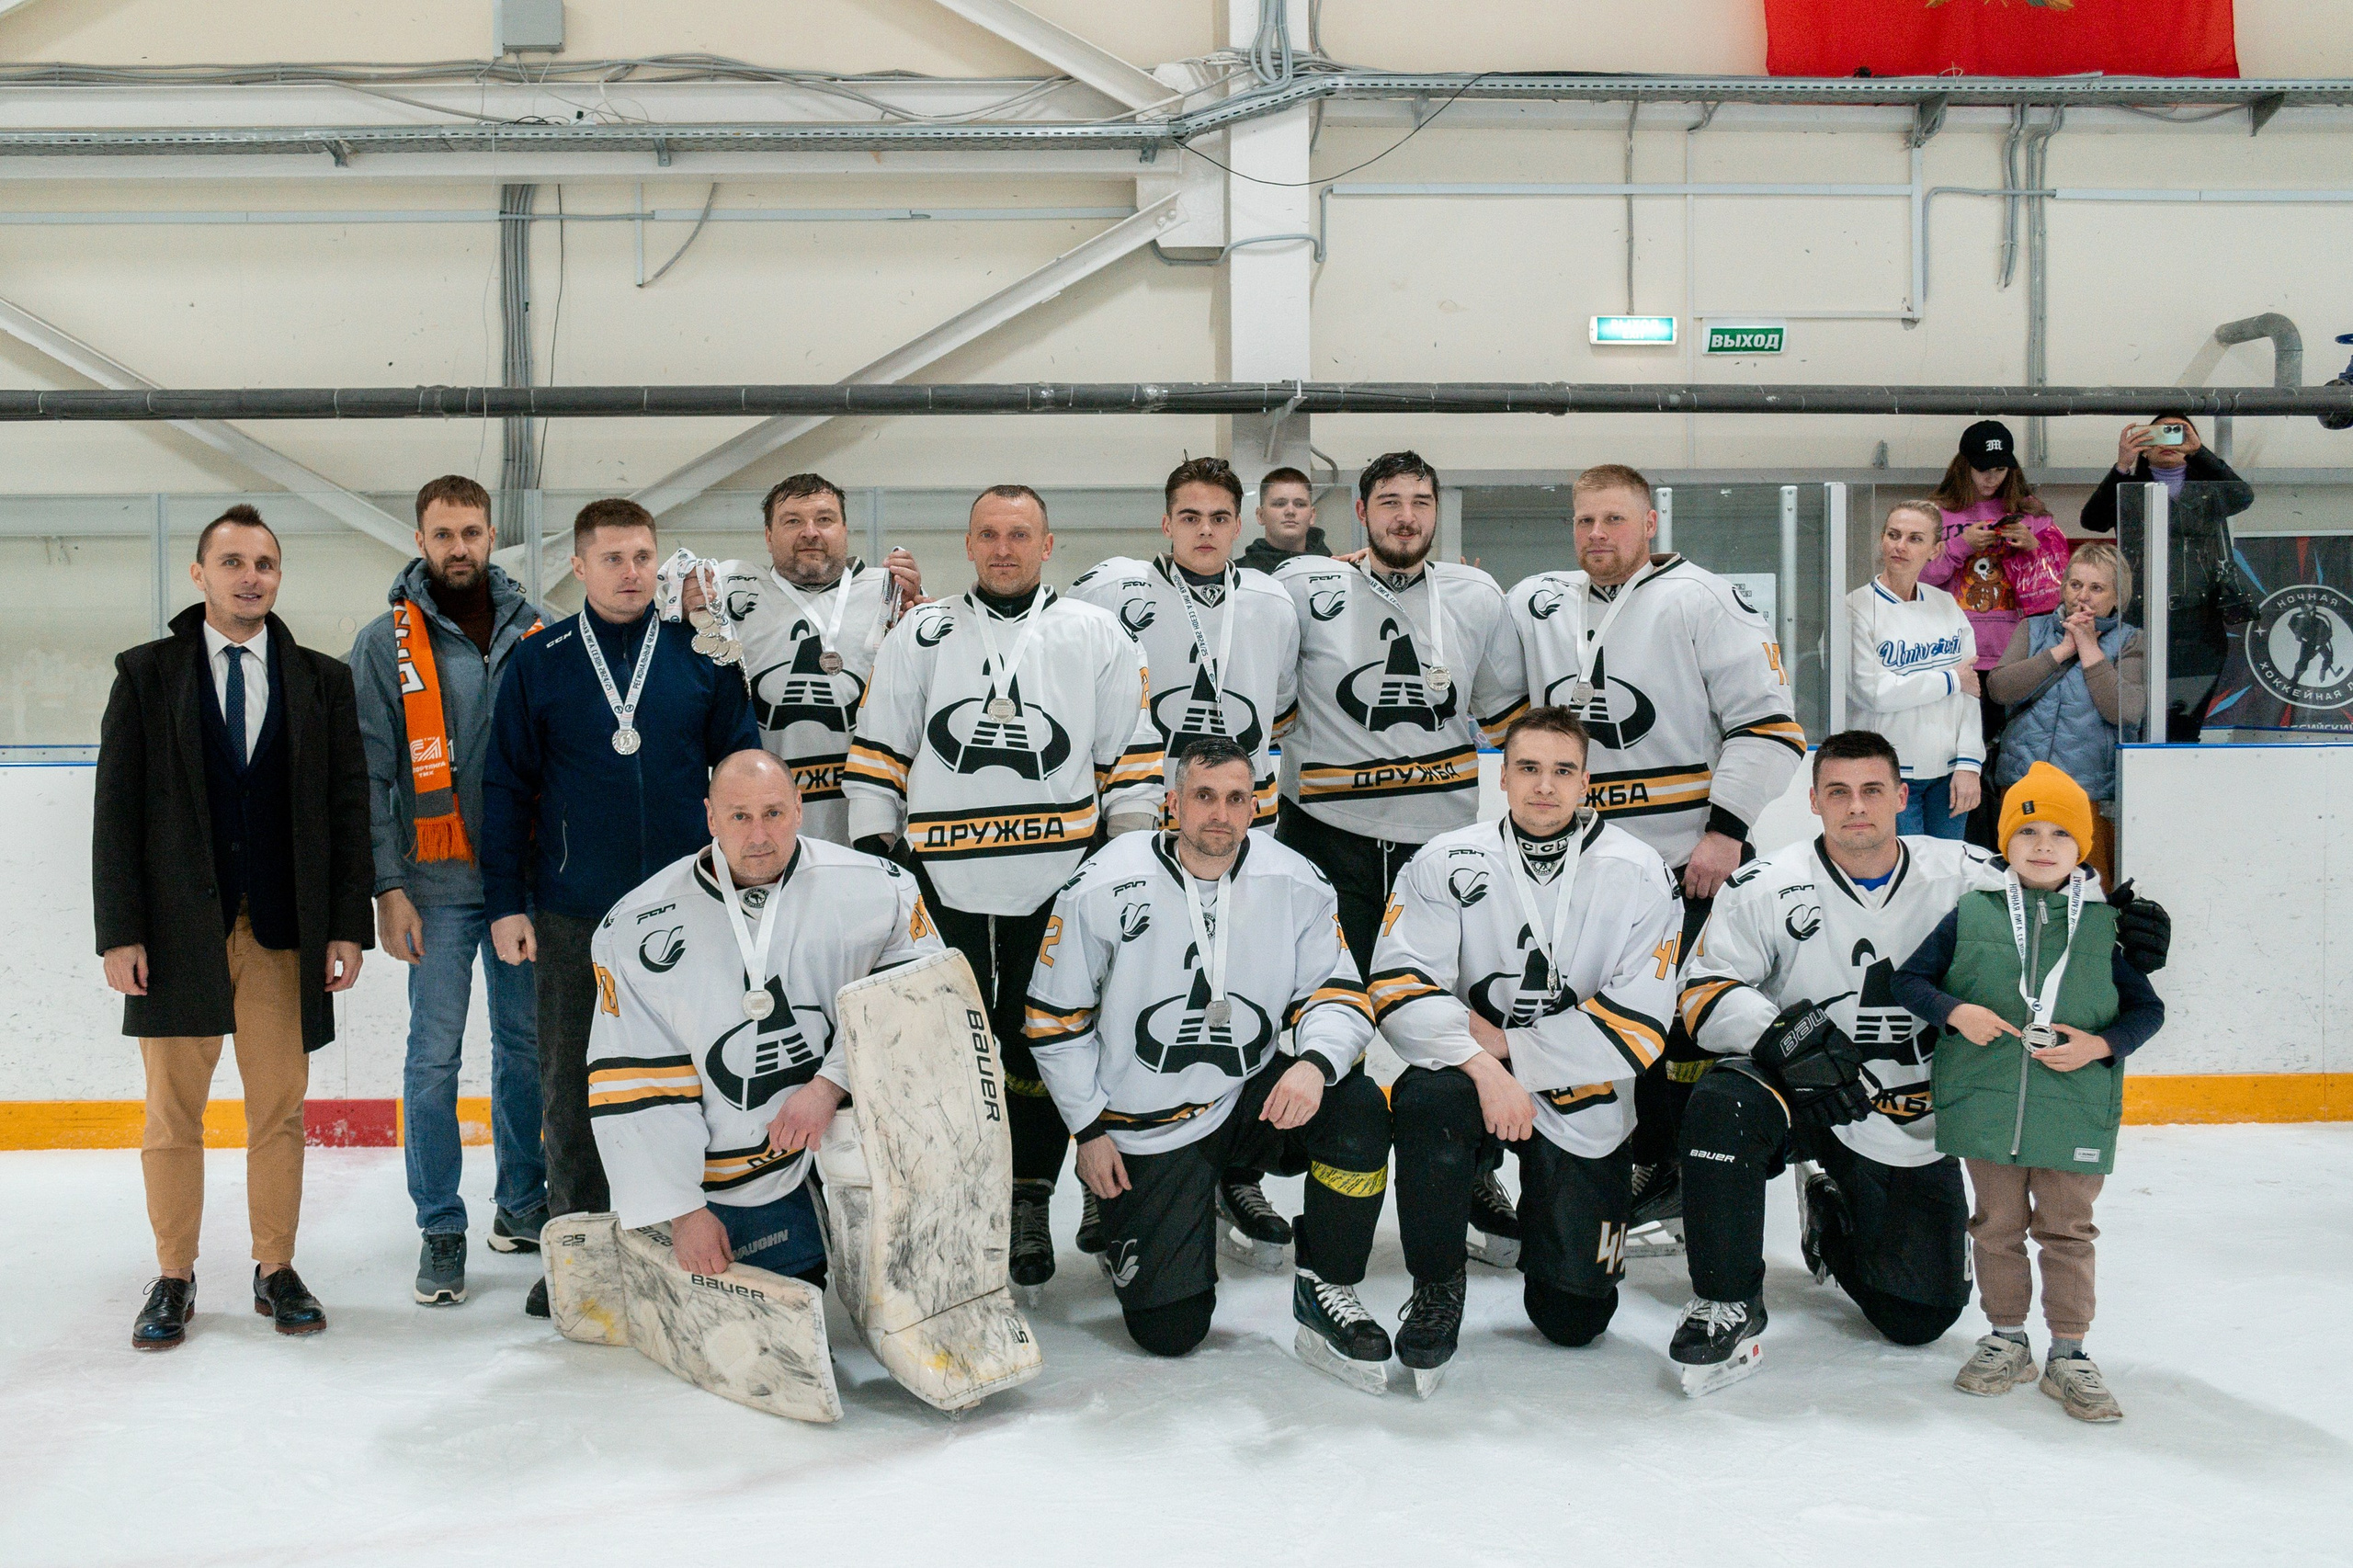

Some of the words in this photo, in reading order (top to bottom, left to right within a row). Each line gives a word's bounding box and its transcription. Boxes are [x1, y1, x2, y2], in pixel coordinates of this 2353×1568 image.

[1711, 334, 1779, 350] ВЫХОД
[1173, 574, 1188, 597] НОЧНАЯ
[1182, 594, 1194, 613] ЛИГА
[1188, 610, 1199, 631] СЕЗОН
[2276, 592, 2339, 609] НОЧНАЯ
[546, 631, 573, 649] CCM
[585, 633, 595, 650] ЛИГА
[590, 648, 604, 669] СЕЗОН
[632, 644, 653, 690] РЕГИОНАЛЬНЫЙ
[2258, 661, 2343, 701] ХОККЕЙНАЯ
[1351, 762, 1461, 790] ДРУЖБА
[924, 816, 1066, 848] ДРУЖБА
[2009, 883, 2020, 912] НОЧНАЯ
[2071, 876, 2082, 917] ЧЕМПИОНАТ
[2014, 912, 2023, 932] ЛИГА
[562, 1233, 586, 1247] 25
[1005, 1316, 1029, 1344] 25
